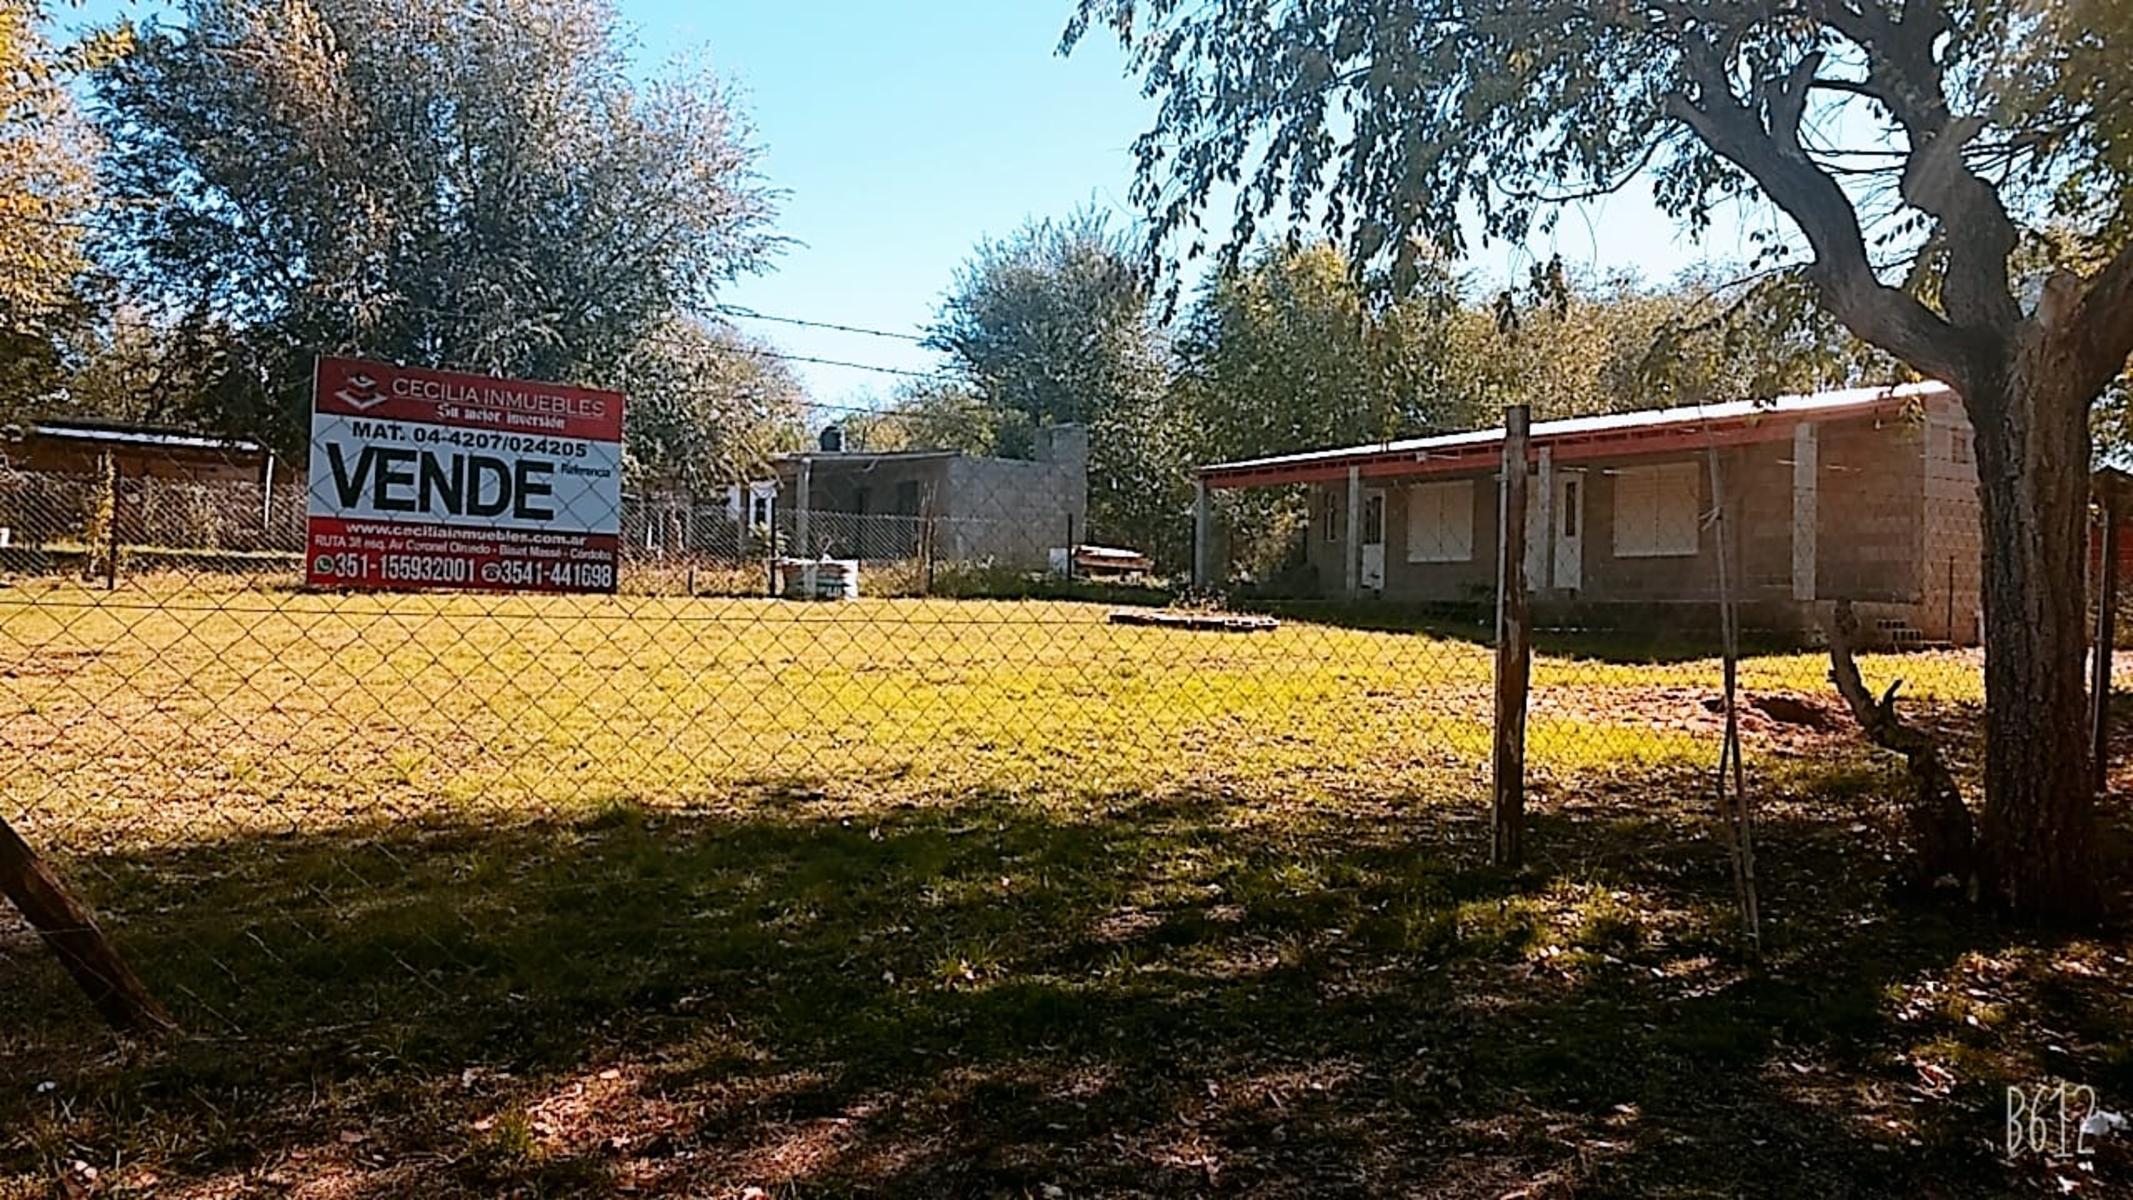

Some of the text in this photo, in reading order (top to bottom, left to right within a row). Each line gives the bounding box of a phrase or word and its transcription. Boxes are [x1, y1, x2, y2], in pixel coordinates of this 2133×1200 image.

[391, 377, 605, 417] CECILIA INMUEBLES
[437, 402, 460, 418] Su
[352, 420, 588, 458] MAT. 04-4207/024205
[325, 442, 555, 521] VENDE
[560, 462, 611, 479] Referencia
[314, 534, 347, 547] RUTA
[345, 522, 587, 547] www.ceciliainmuebles.com.ar
[335, 552, 613, 588] 351-155932001 3541-441698
